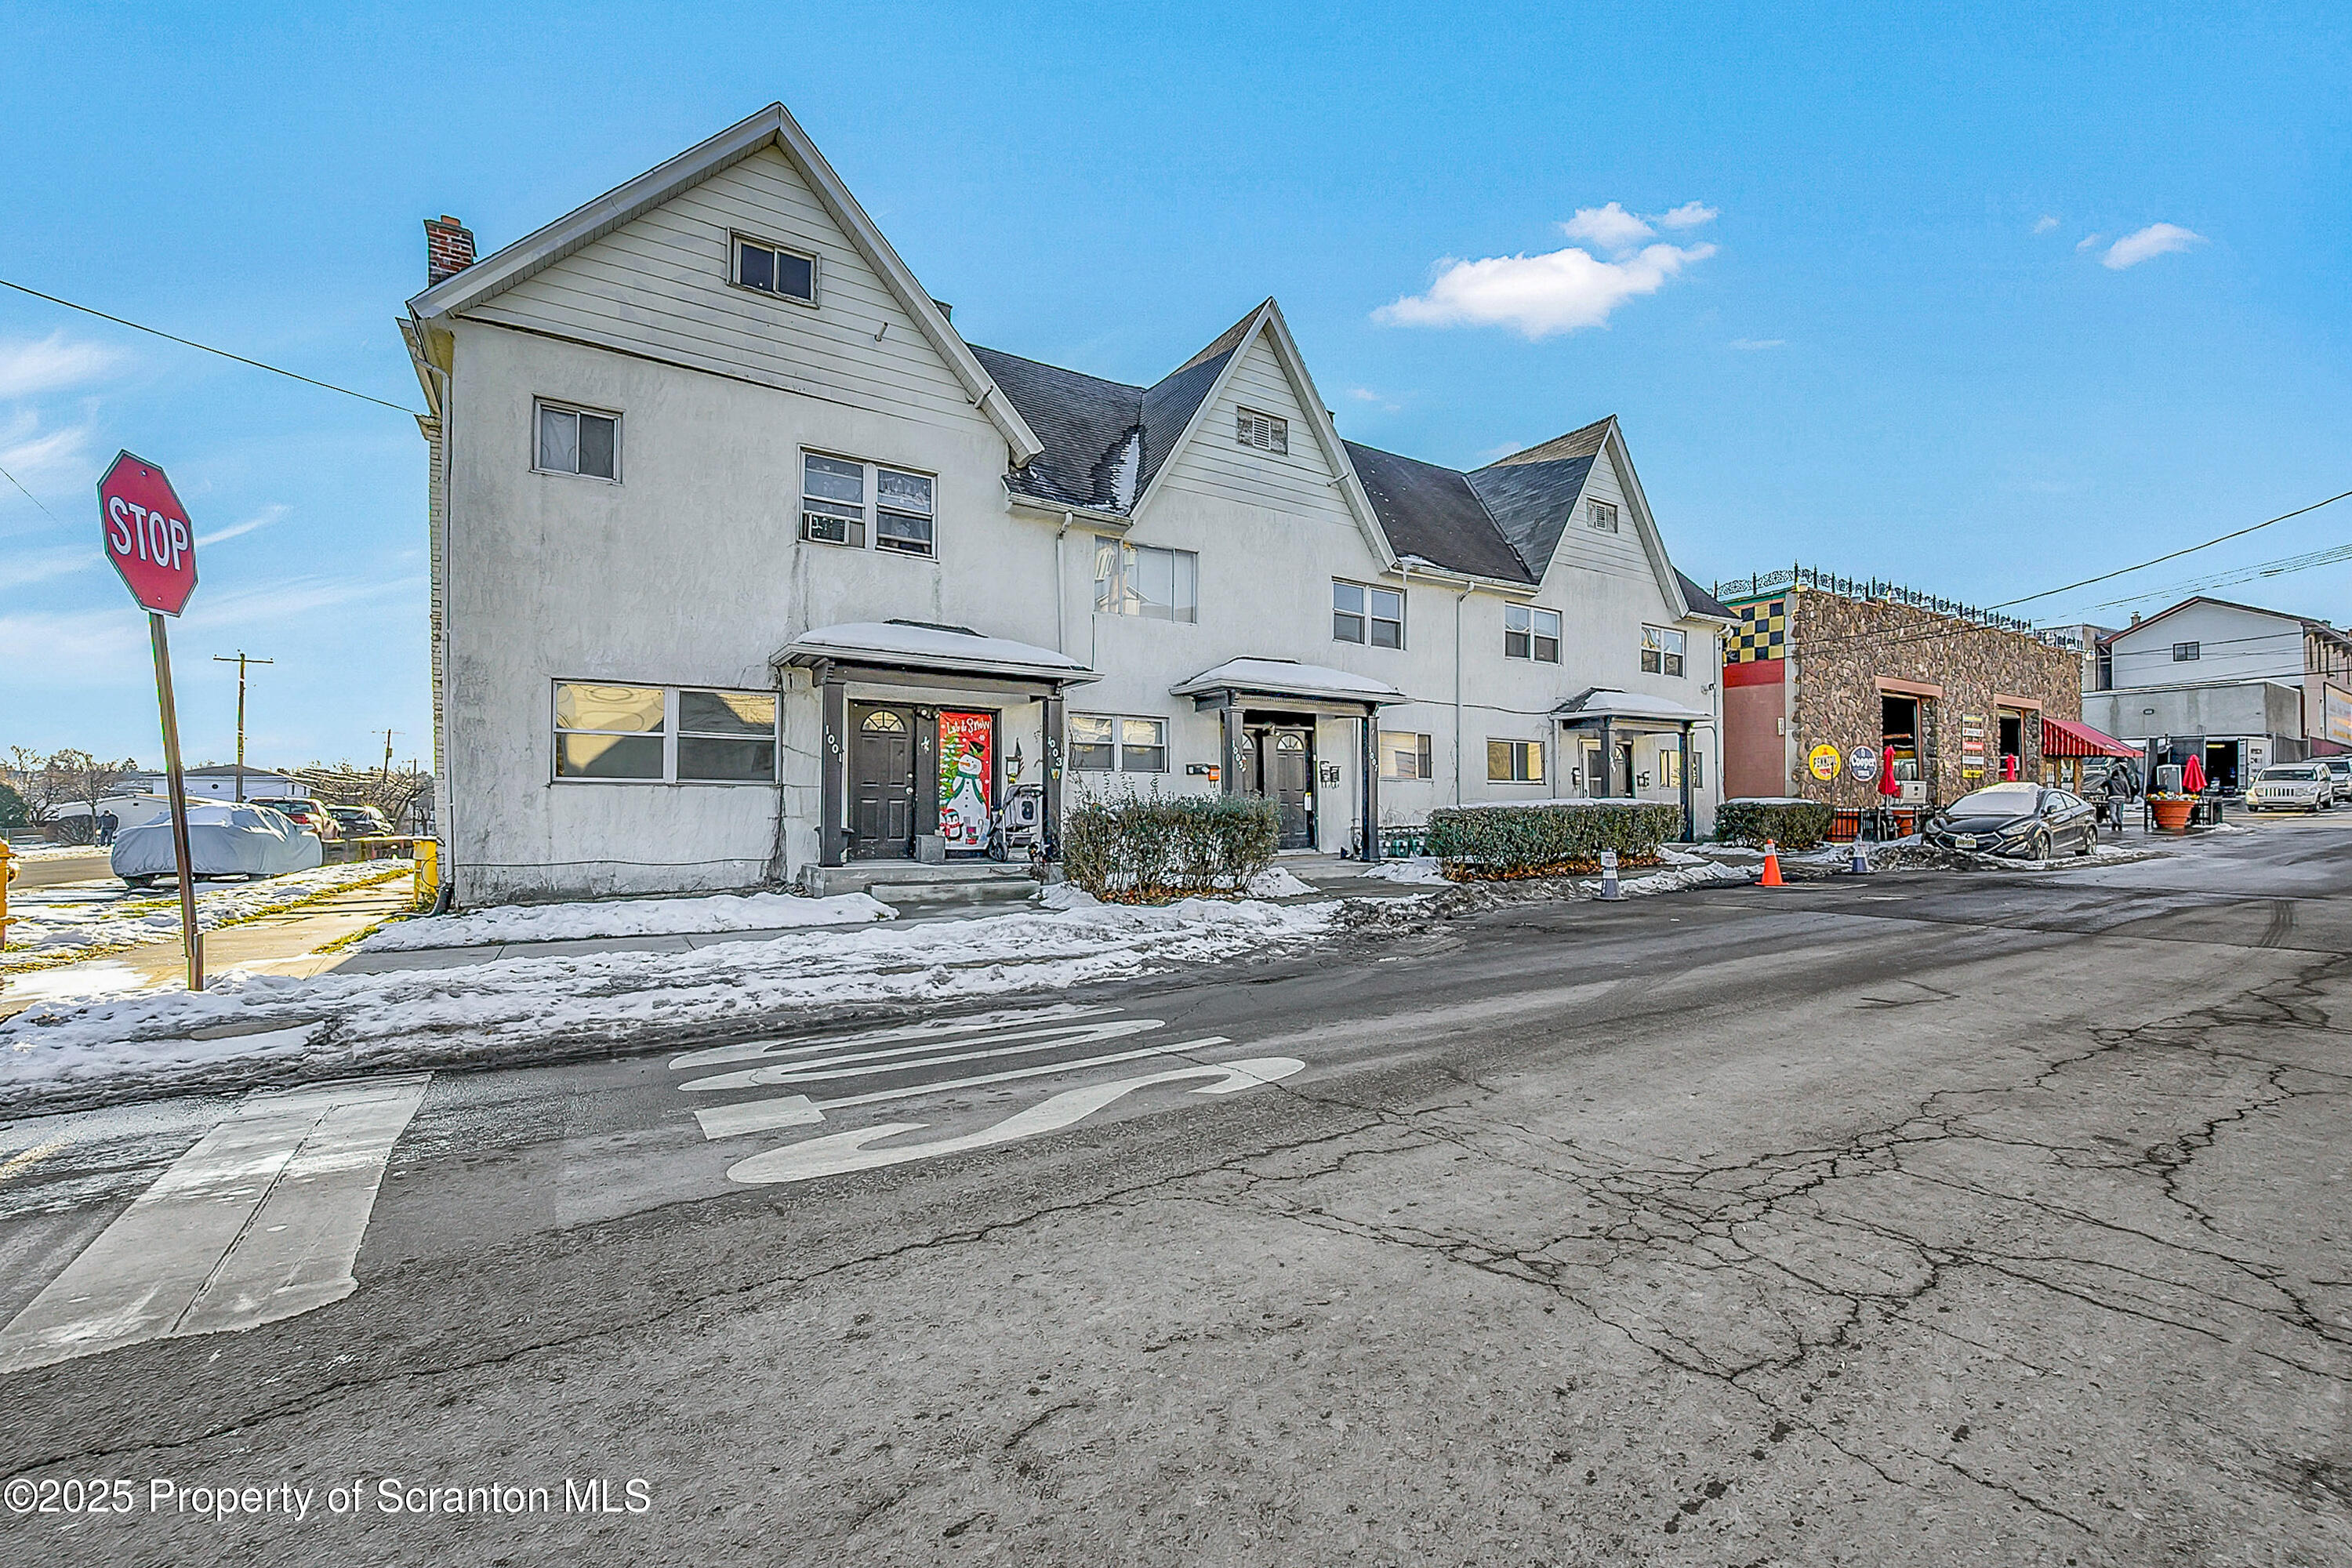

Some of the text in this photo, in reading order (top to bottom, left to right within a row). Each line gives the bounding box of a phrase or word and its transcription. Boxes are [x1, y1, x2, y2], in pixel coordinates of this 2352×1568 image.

[109, 495, 188, 571] STOP
[967, 717, 990, 734] Snow
[826, 724, 842, 763] 1001
[1047, 736, 1062, 767] 1003
[1851, 754, 1875, 769] Cooper
